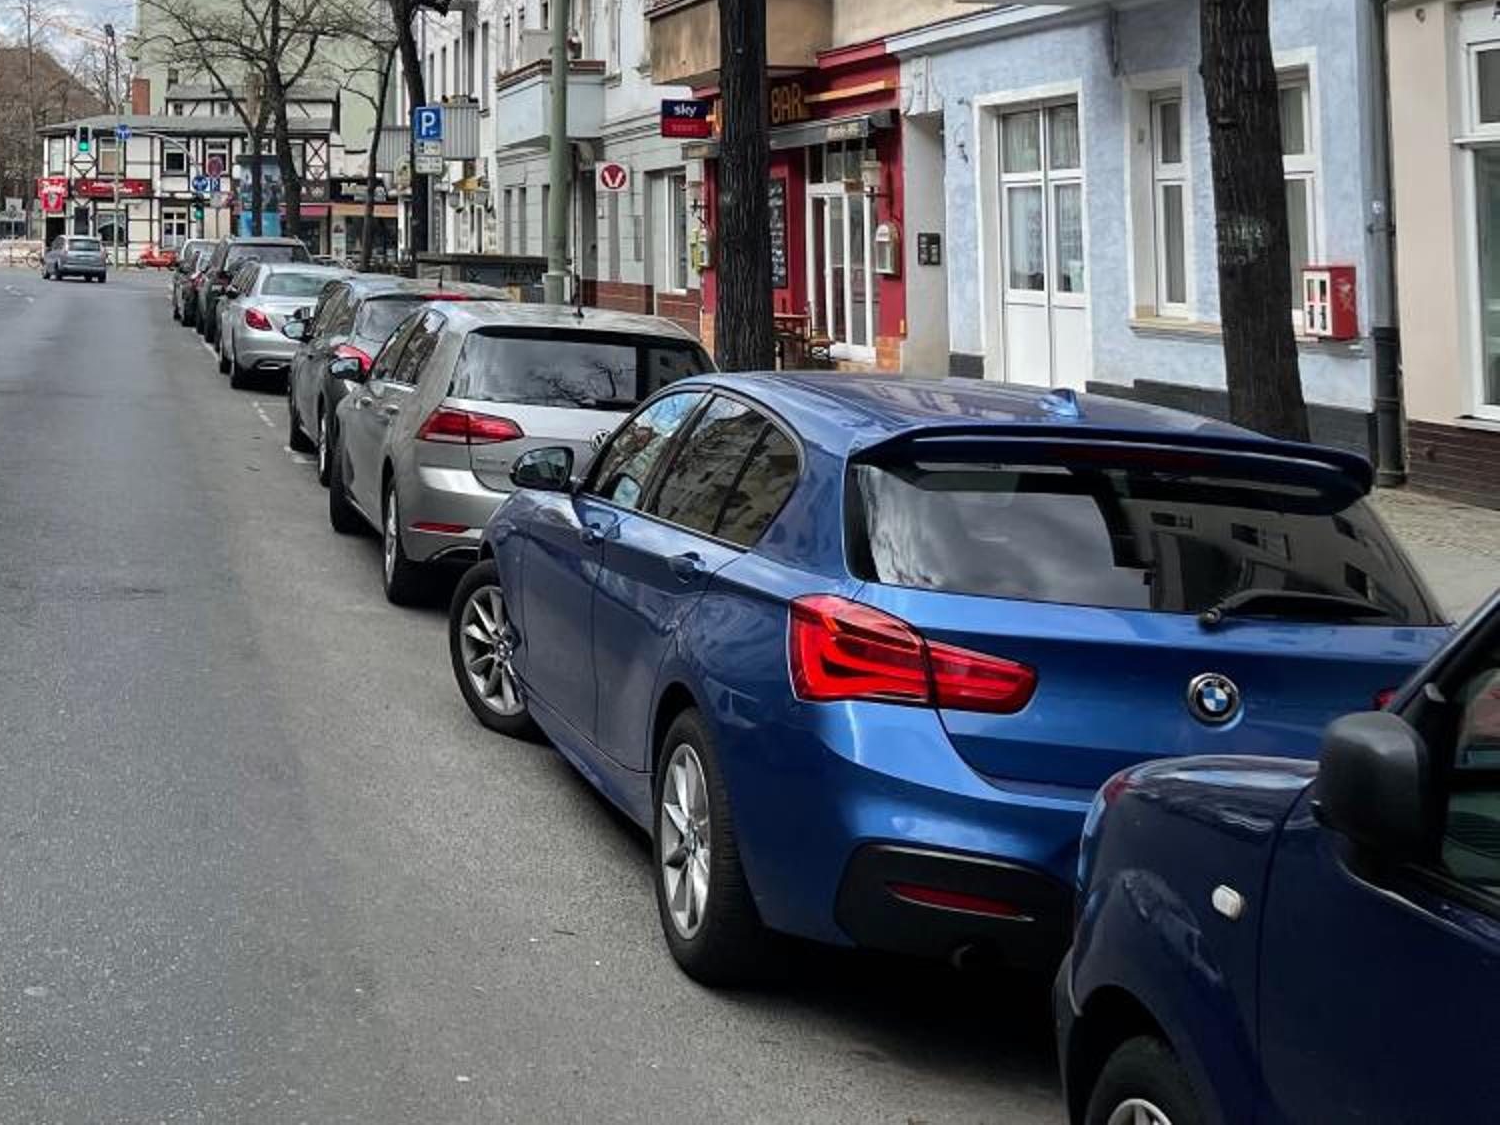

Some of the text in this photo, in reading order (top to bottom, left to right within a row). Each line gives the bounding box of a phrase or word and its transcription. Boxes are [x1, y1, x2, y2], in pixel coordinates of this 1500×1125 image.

[673, 103, 698, 118] sky
[771, 83, 802, 124] BAR
[421, 111, 435, 136] P
